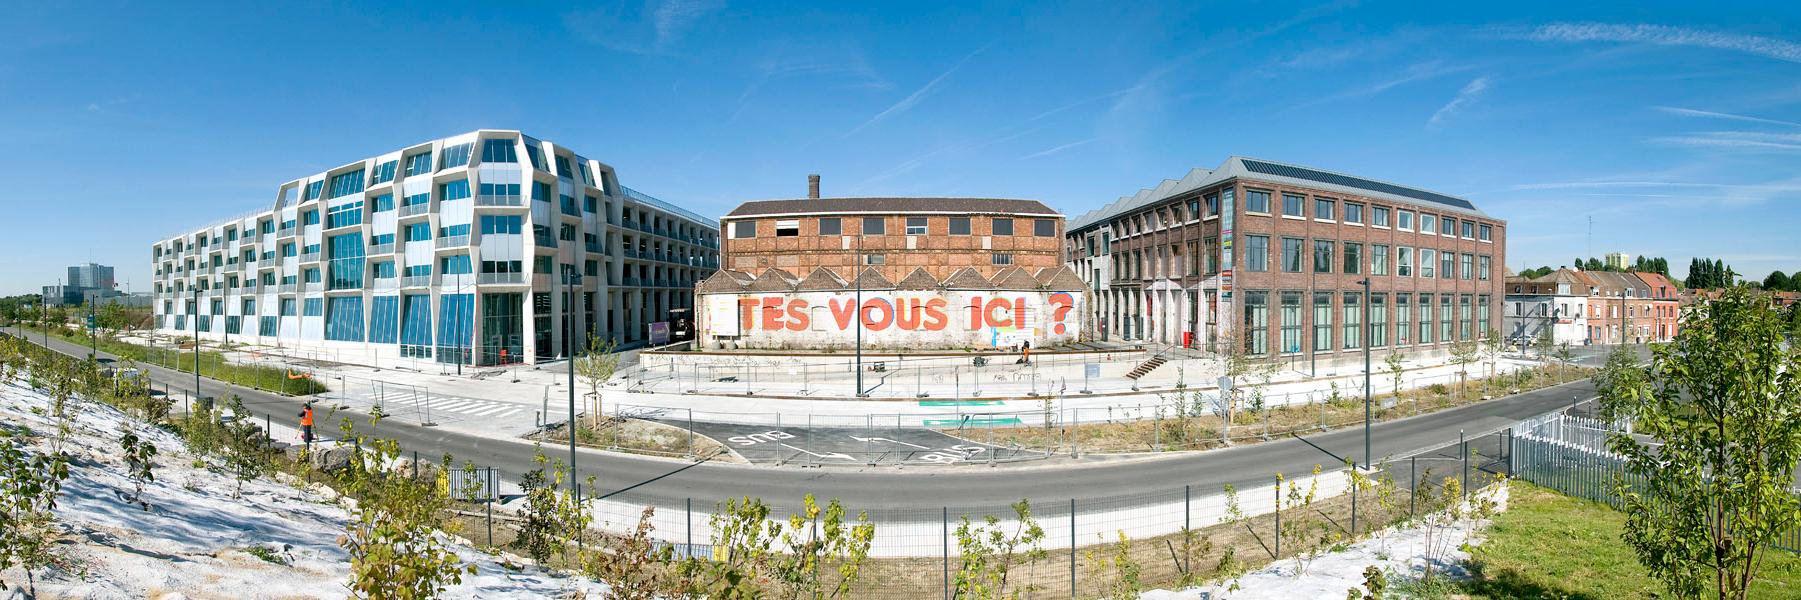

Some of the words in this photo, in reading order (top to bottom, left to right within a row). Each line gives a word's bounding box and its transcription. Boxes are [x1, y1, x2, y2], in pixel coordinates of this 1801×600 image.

[709, 297, 809, 331] TES
[828, 297, 948, 331] VOUS
[971, 296, 1026, 330] ICI
[1048, 291, 1075, 335] ?
[728, 430, 796, 446] BUS
[919, 445, 986, 464] BUS
